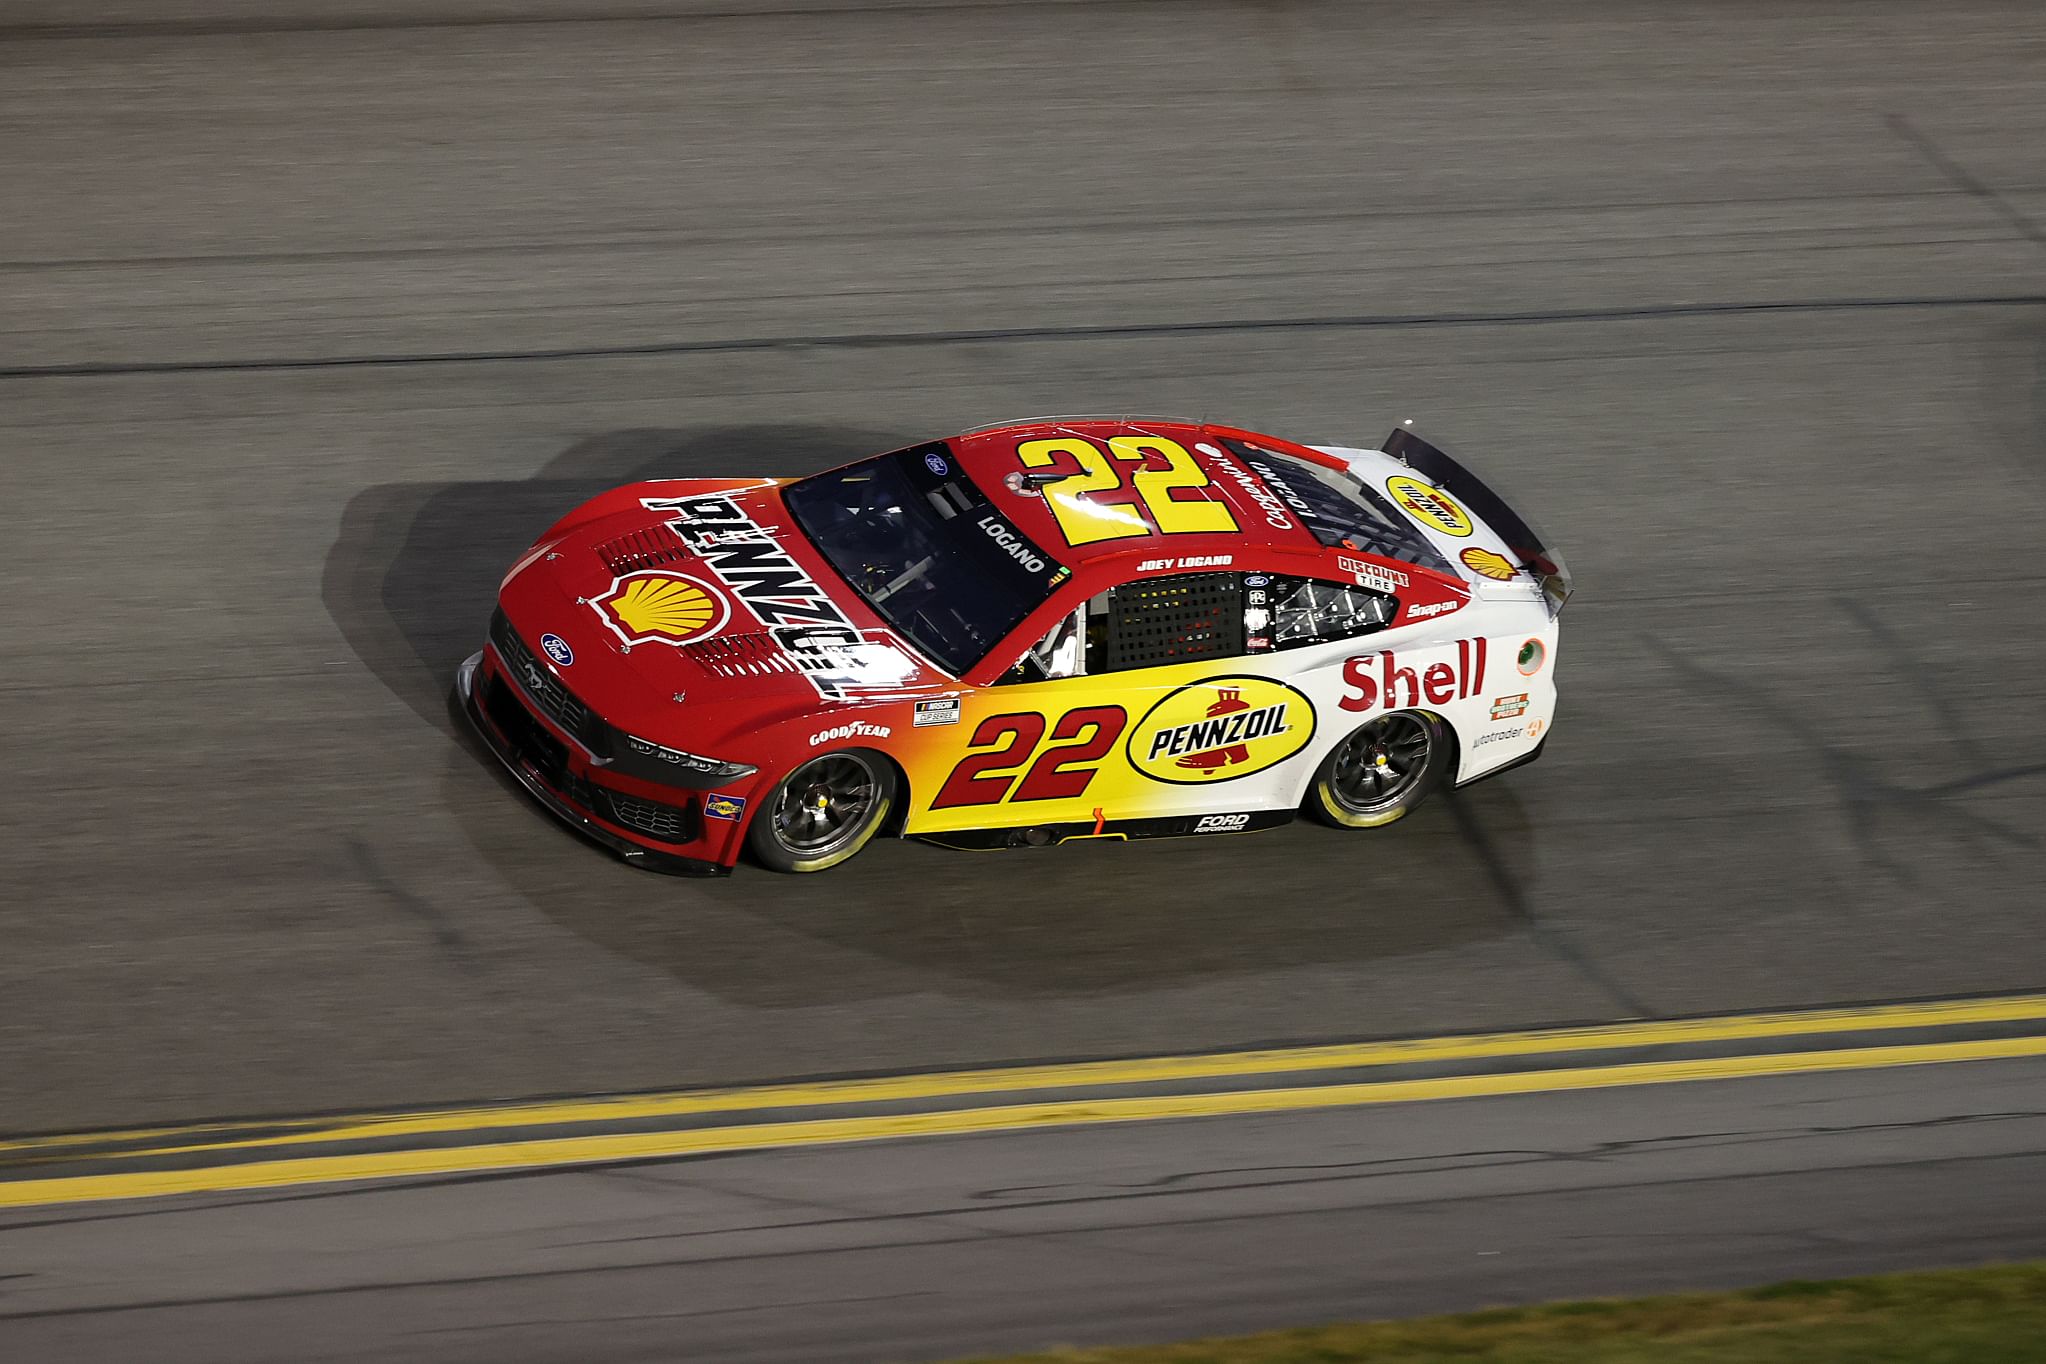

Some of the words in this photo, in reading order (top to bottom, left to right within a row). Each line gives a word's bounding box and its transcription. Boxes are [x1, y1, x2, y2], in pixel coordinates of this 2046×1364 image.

[1017, 435, 1242, 548] 22
[1209, 457, 1293, 530] Capgemini
[1398, 484, 1464, 529] PENNZOIL
[977, 516, 1045, 573] LOGANO
[1136, 558, 1175, 572] JOEY
[1177, 555, 1233, 568] LOGANO
[1338, 556, 1410, 588] DISCOUNT
[1360, 575, 1390, 590] TIRE
[1406, 600, 1458, 618] Snap-on
[544, 638, 569, 661] Ford
[1338, 637, 1487, 713] Shell
[809, 720, 891, 747] GOODYEAR
[1148, 704, 1286, 761] PENNZOIL
[927, 704, 1128, 811] 22
[708, 802, 742, 813] SUNOCO
[1197, 814, 1250, 828] FORD
